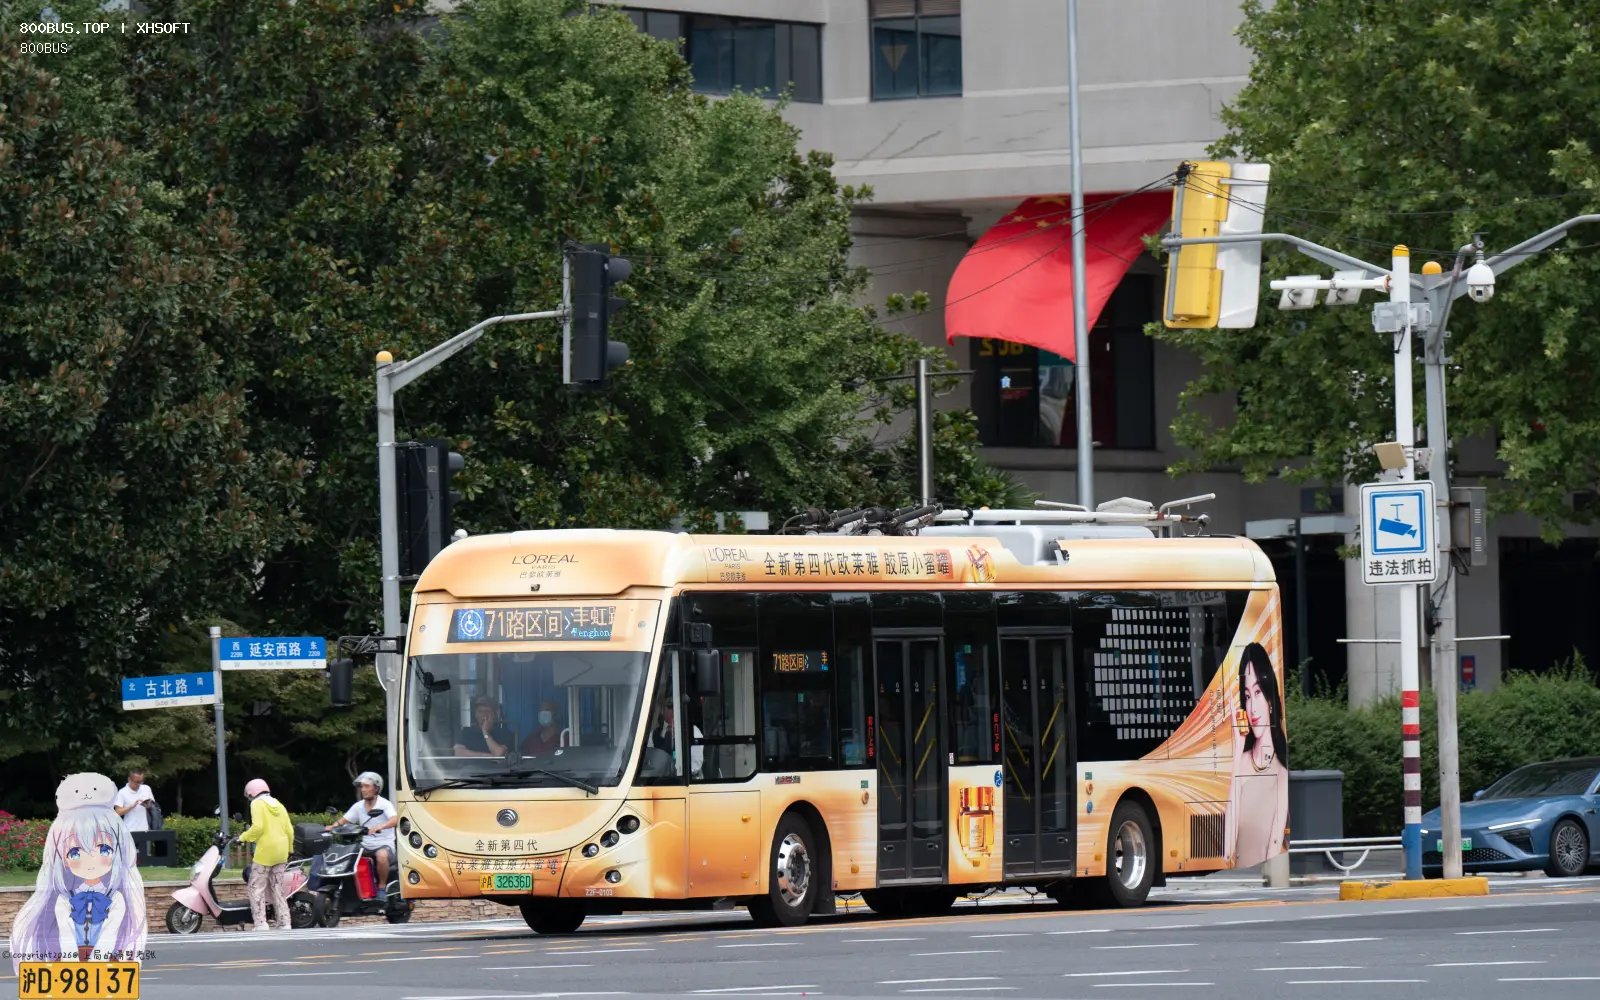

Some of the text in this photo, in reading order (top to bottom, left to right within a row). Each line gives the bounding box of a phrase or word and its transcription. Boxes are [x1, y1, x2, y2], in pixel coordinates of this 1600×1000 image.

[764, 551, 950, 577] 全新第四代欧莱雅 胶原小蜜罐
[1369, 558, 1432, 577] 违法抓拍
[484, 608, 563, 640] 71路区间
[232, 641, 240, 651] 西
[249, 642, 302, 658] 延安西路
[310, 641, 318, 650] 东
[772, 653, 805, 672] 71路区间
[128, 682, 136, 691] 北
[145, 678, 188, 697] 古北路
[475, 839, 538, 852] 全新第四代
[455, 857, 560, 872] 欧莱雅胶原小蜜罐
